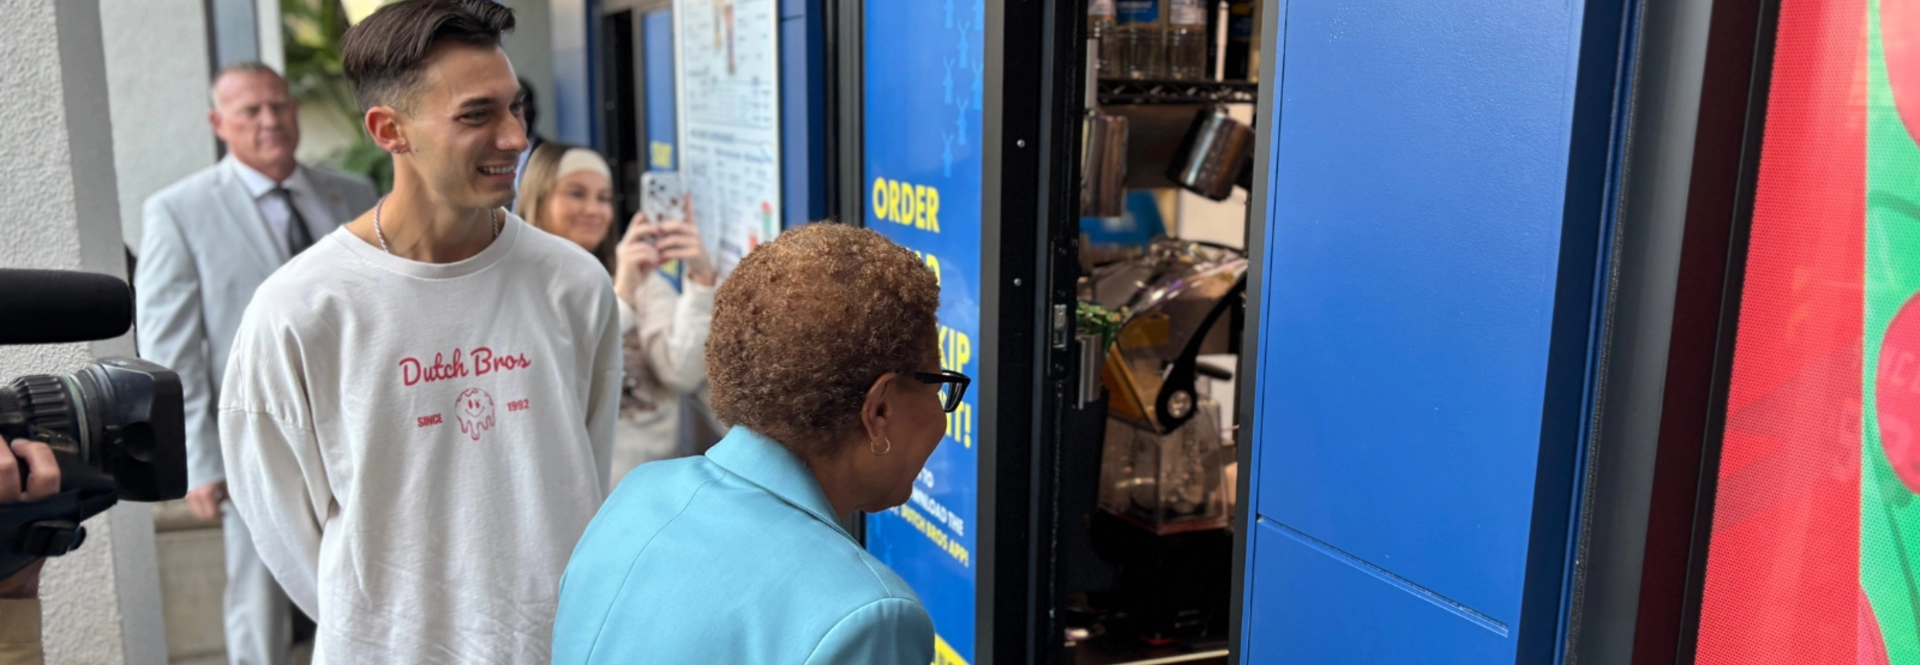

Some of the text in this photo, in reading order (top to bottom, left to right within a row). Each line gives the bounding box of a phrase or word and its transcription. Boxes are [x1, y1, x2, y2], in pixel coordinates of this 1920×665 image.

[872, 176, 941, 234] ORDER
[399, 346, 532, 387] Dutch Bros
[937, 324, 971, 374] KIP
[417, 398, 530, 428] SINCE 1992
[926, 520, 949, 552] BROS
[947, 510, 964, 537] THE
